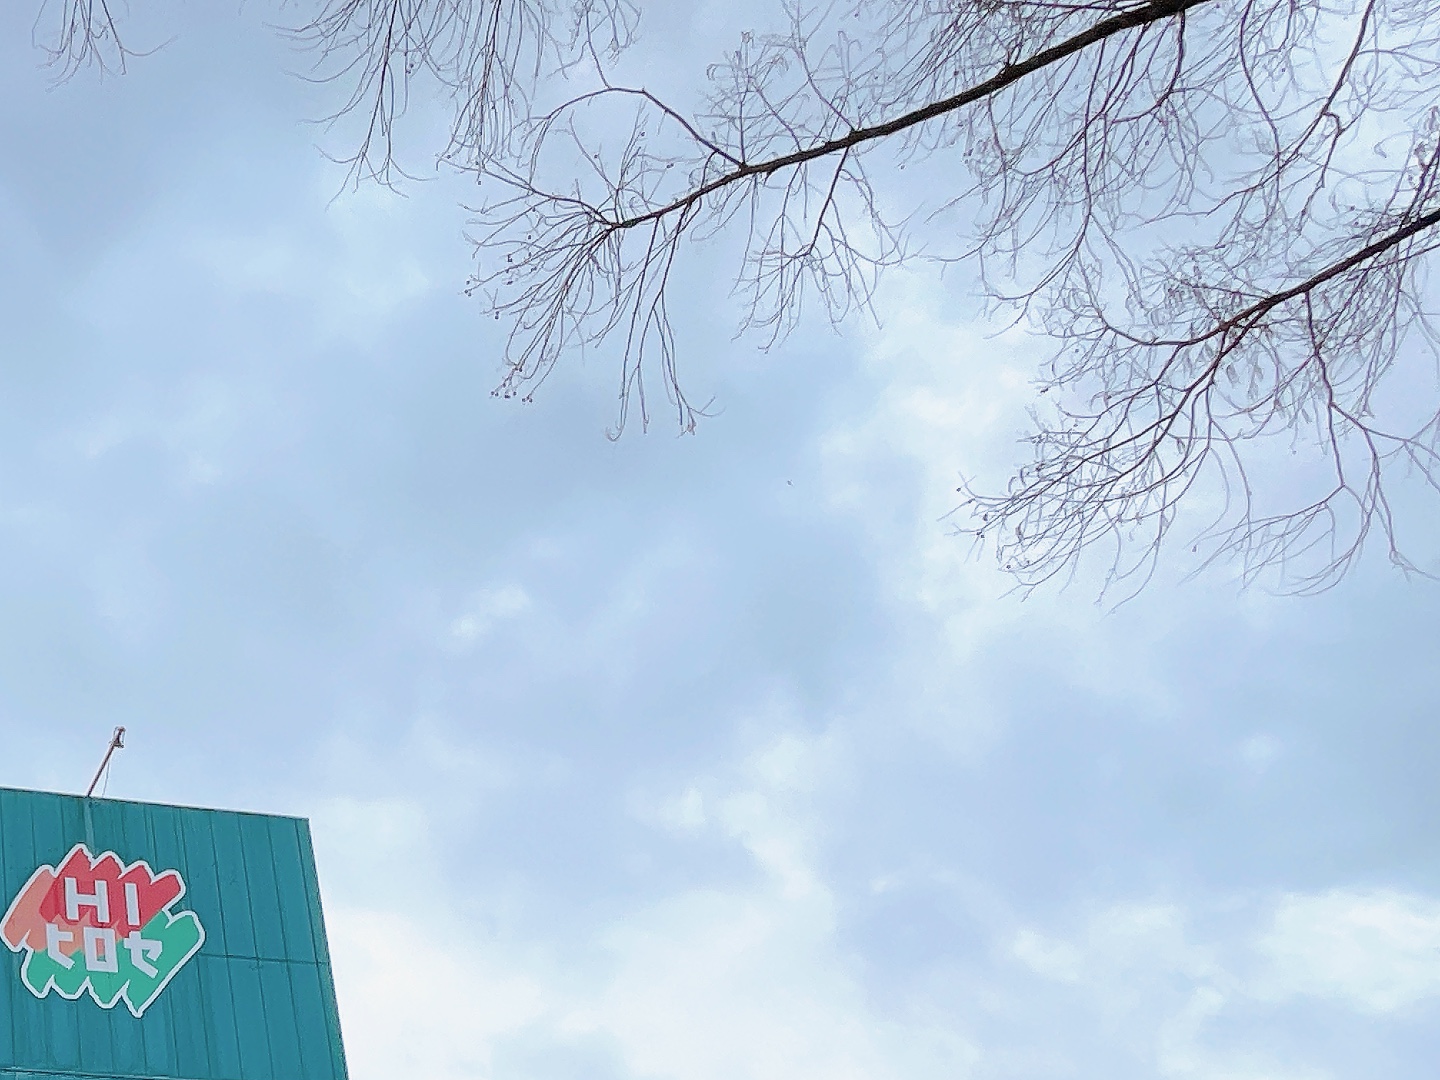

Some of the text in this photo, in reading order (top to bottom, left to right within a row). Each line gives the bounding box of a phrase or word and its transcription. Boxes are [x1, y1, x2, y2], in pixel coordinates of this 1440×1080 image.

[64, 877, 140, 927] HI
[45, 923, 163, 979] ヒロセ
